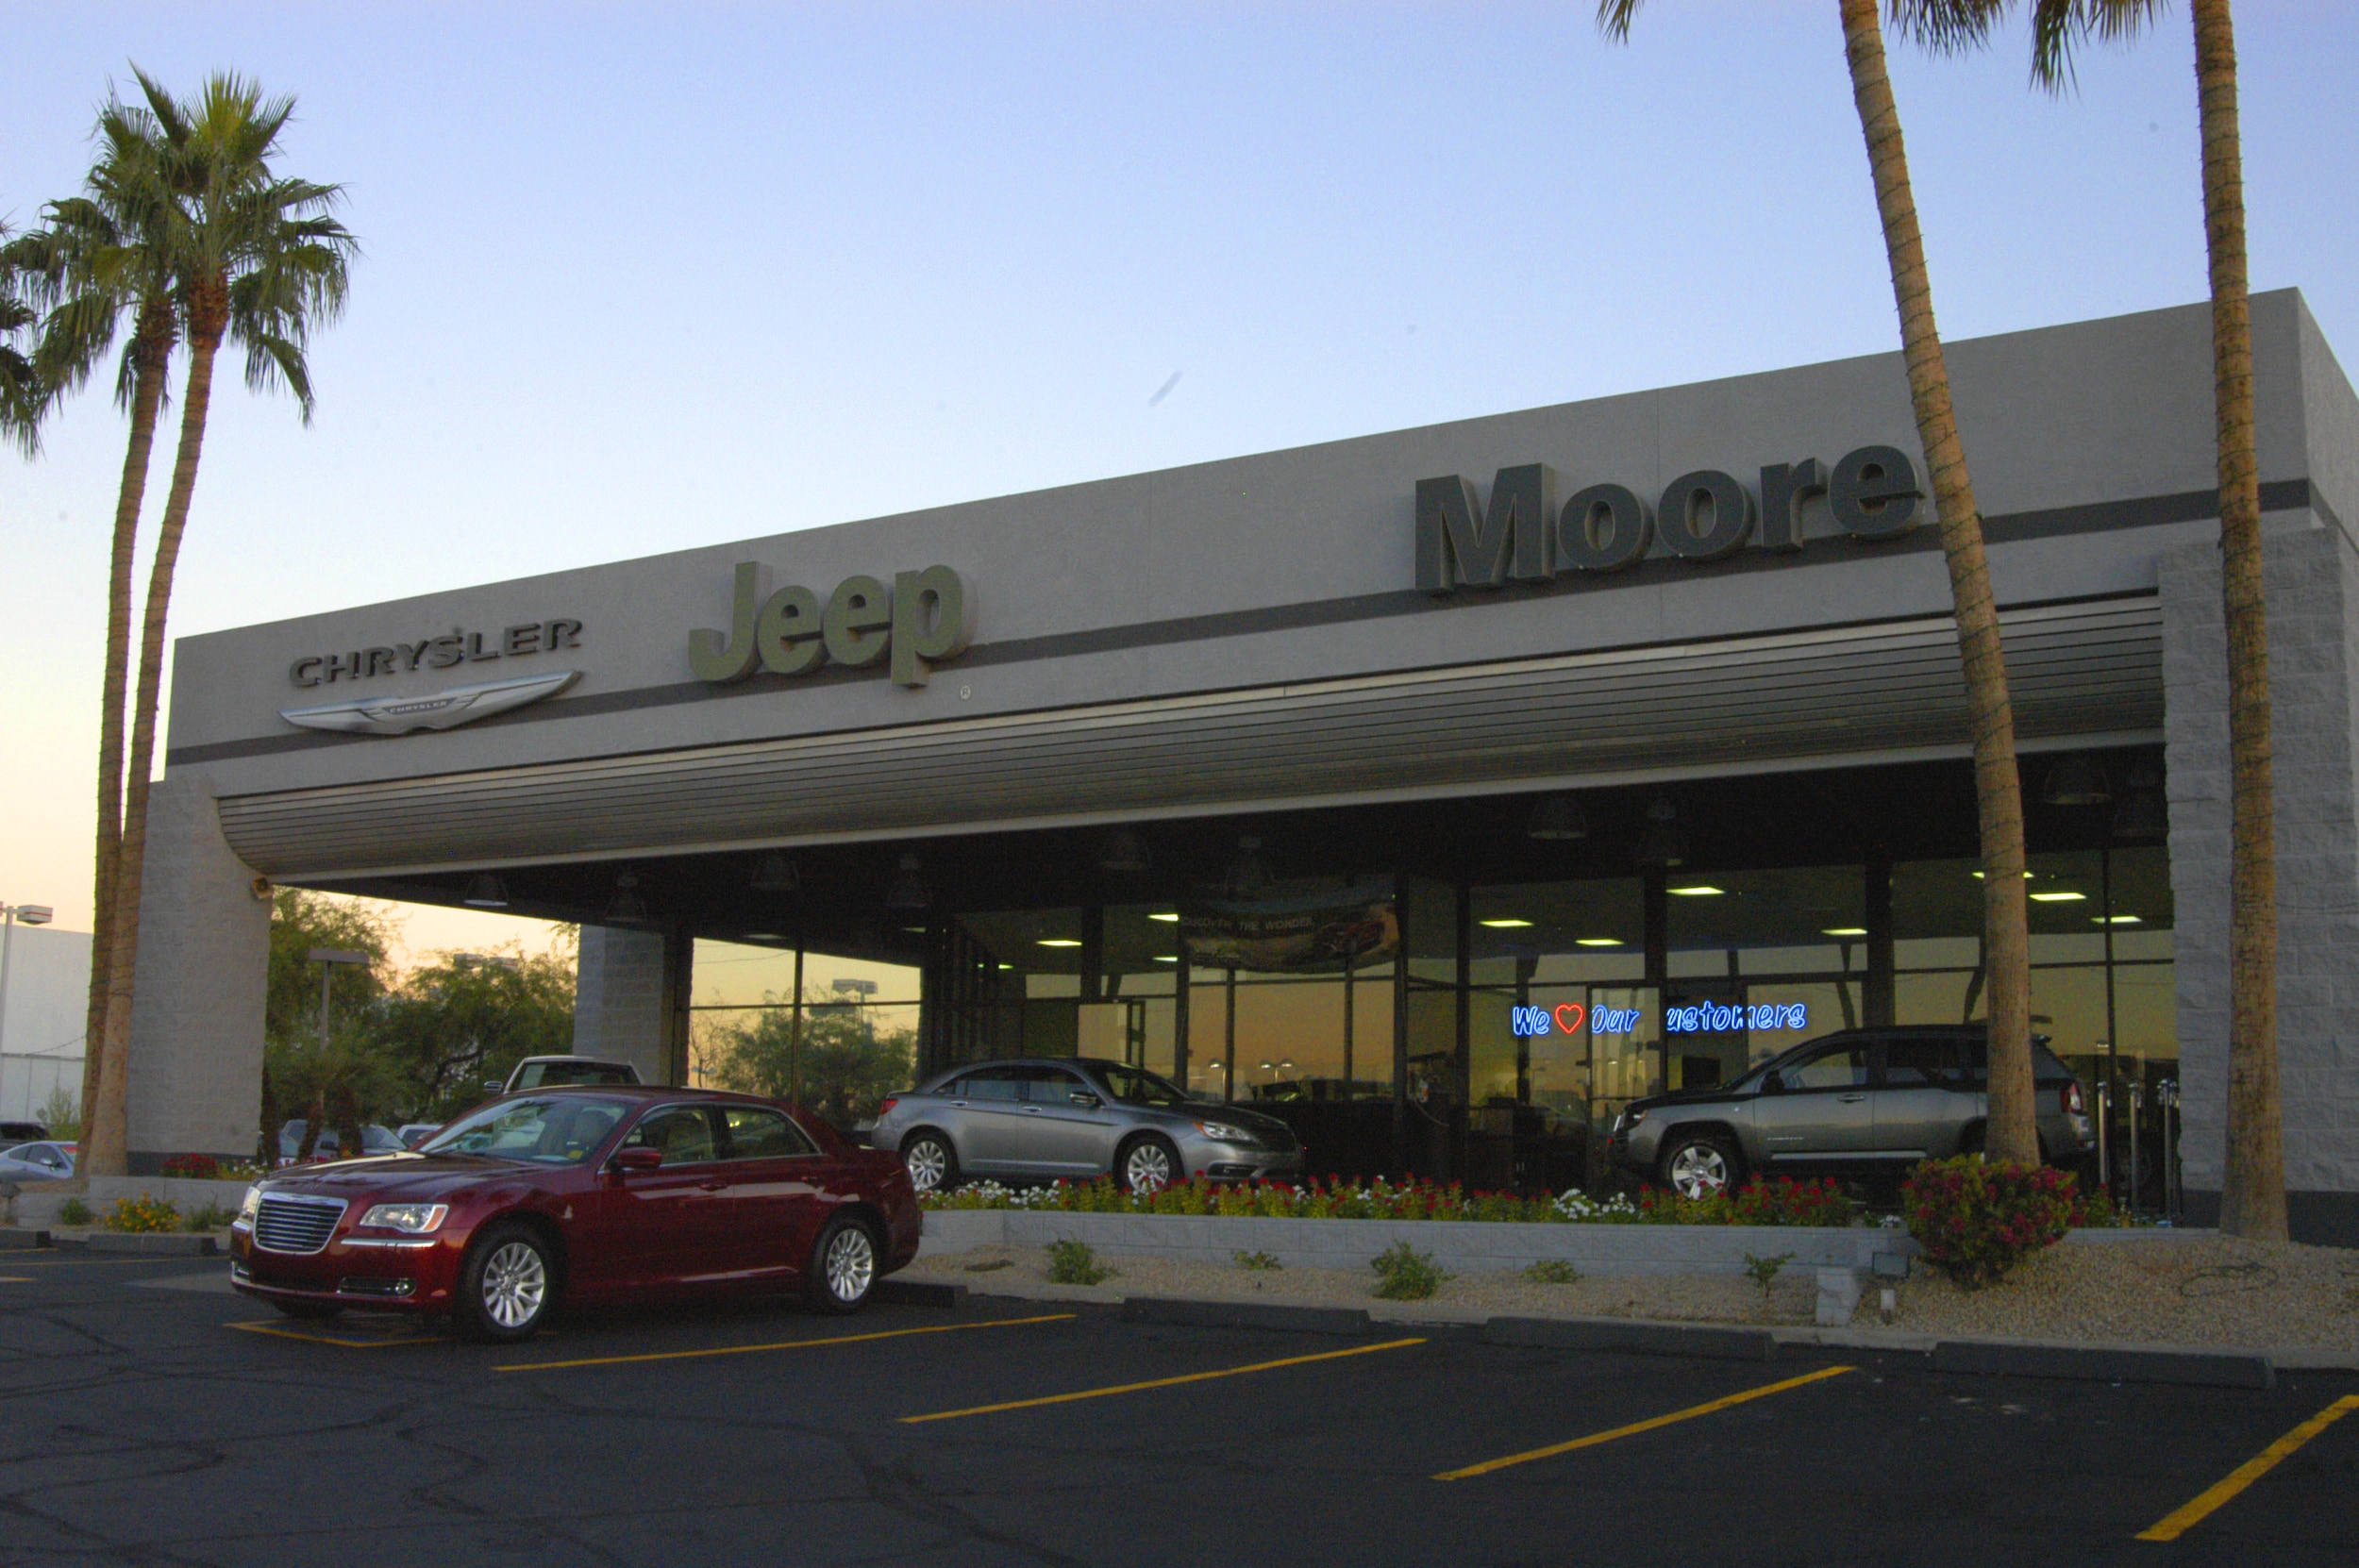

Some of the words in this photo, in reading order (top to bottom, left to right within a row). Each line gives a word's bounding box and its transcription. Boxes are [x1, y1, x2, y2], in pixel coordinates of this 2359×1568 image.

[1414, 444, 1926, 591] Moore
[289, 617, 583, 688] CHRYSLER
[688, 560, 978, 690] Jeep
[389, 701, 448, 713] CHRYSLER
[1512, 1005, 1551, 1036] We
[1591, 1004, 1641, 1035] Our
[1665, 999, 1806, 1033] ustomers
